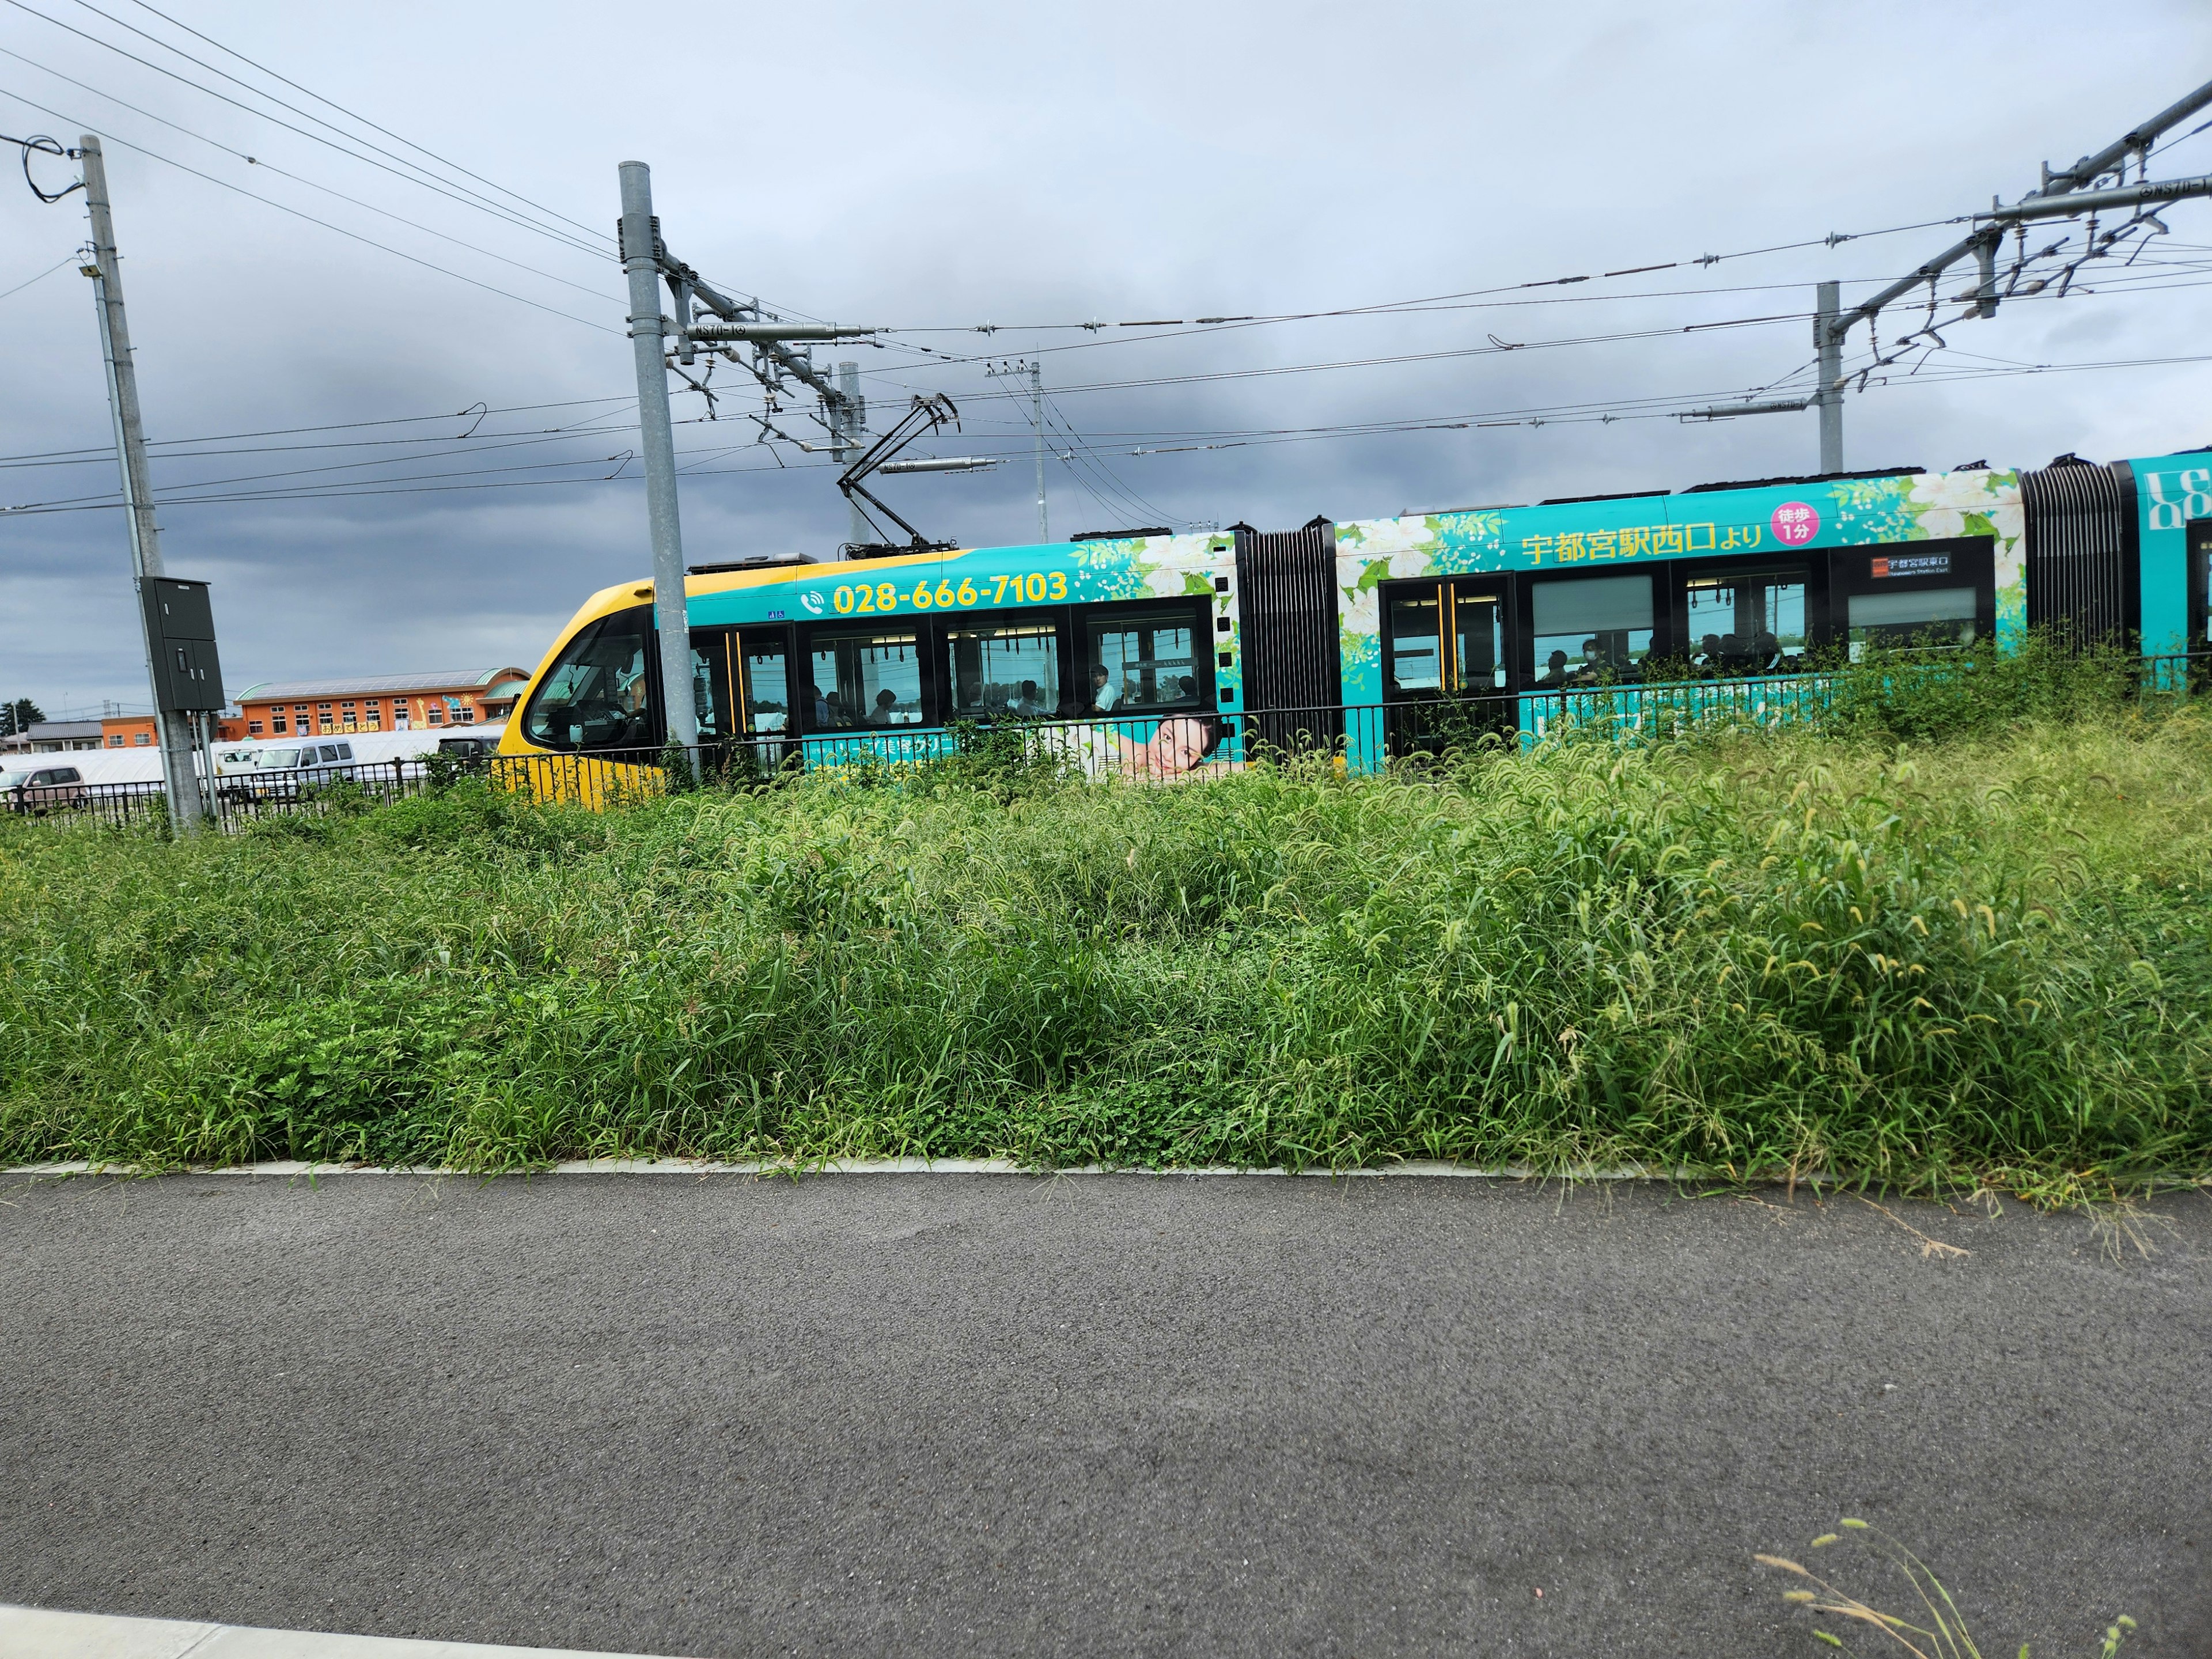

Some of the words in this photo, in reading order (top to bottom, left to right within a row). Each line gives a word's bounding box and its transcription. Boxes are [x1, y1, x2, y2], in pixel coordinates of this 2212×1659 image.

[696, 325, 734, 335] NS70-1
[1778, 507, 1810, 524] 徒歩
[1783, 524, 1810, 540] 1分
[1521, 522, 1762, 565] 宇都宮駅西口より
[1888, 556, 1948, 569] 宇都宮駅東口
[833, 571, 1068, 614] 028-666-7103
